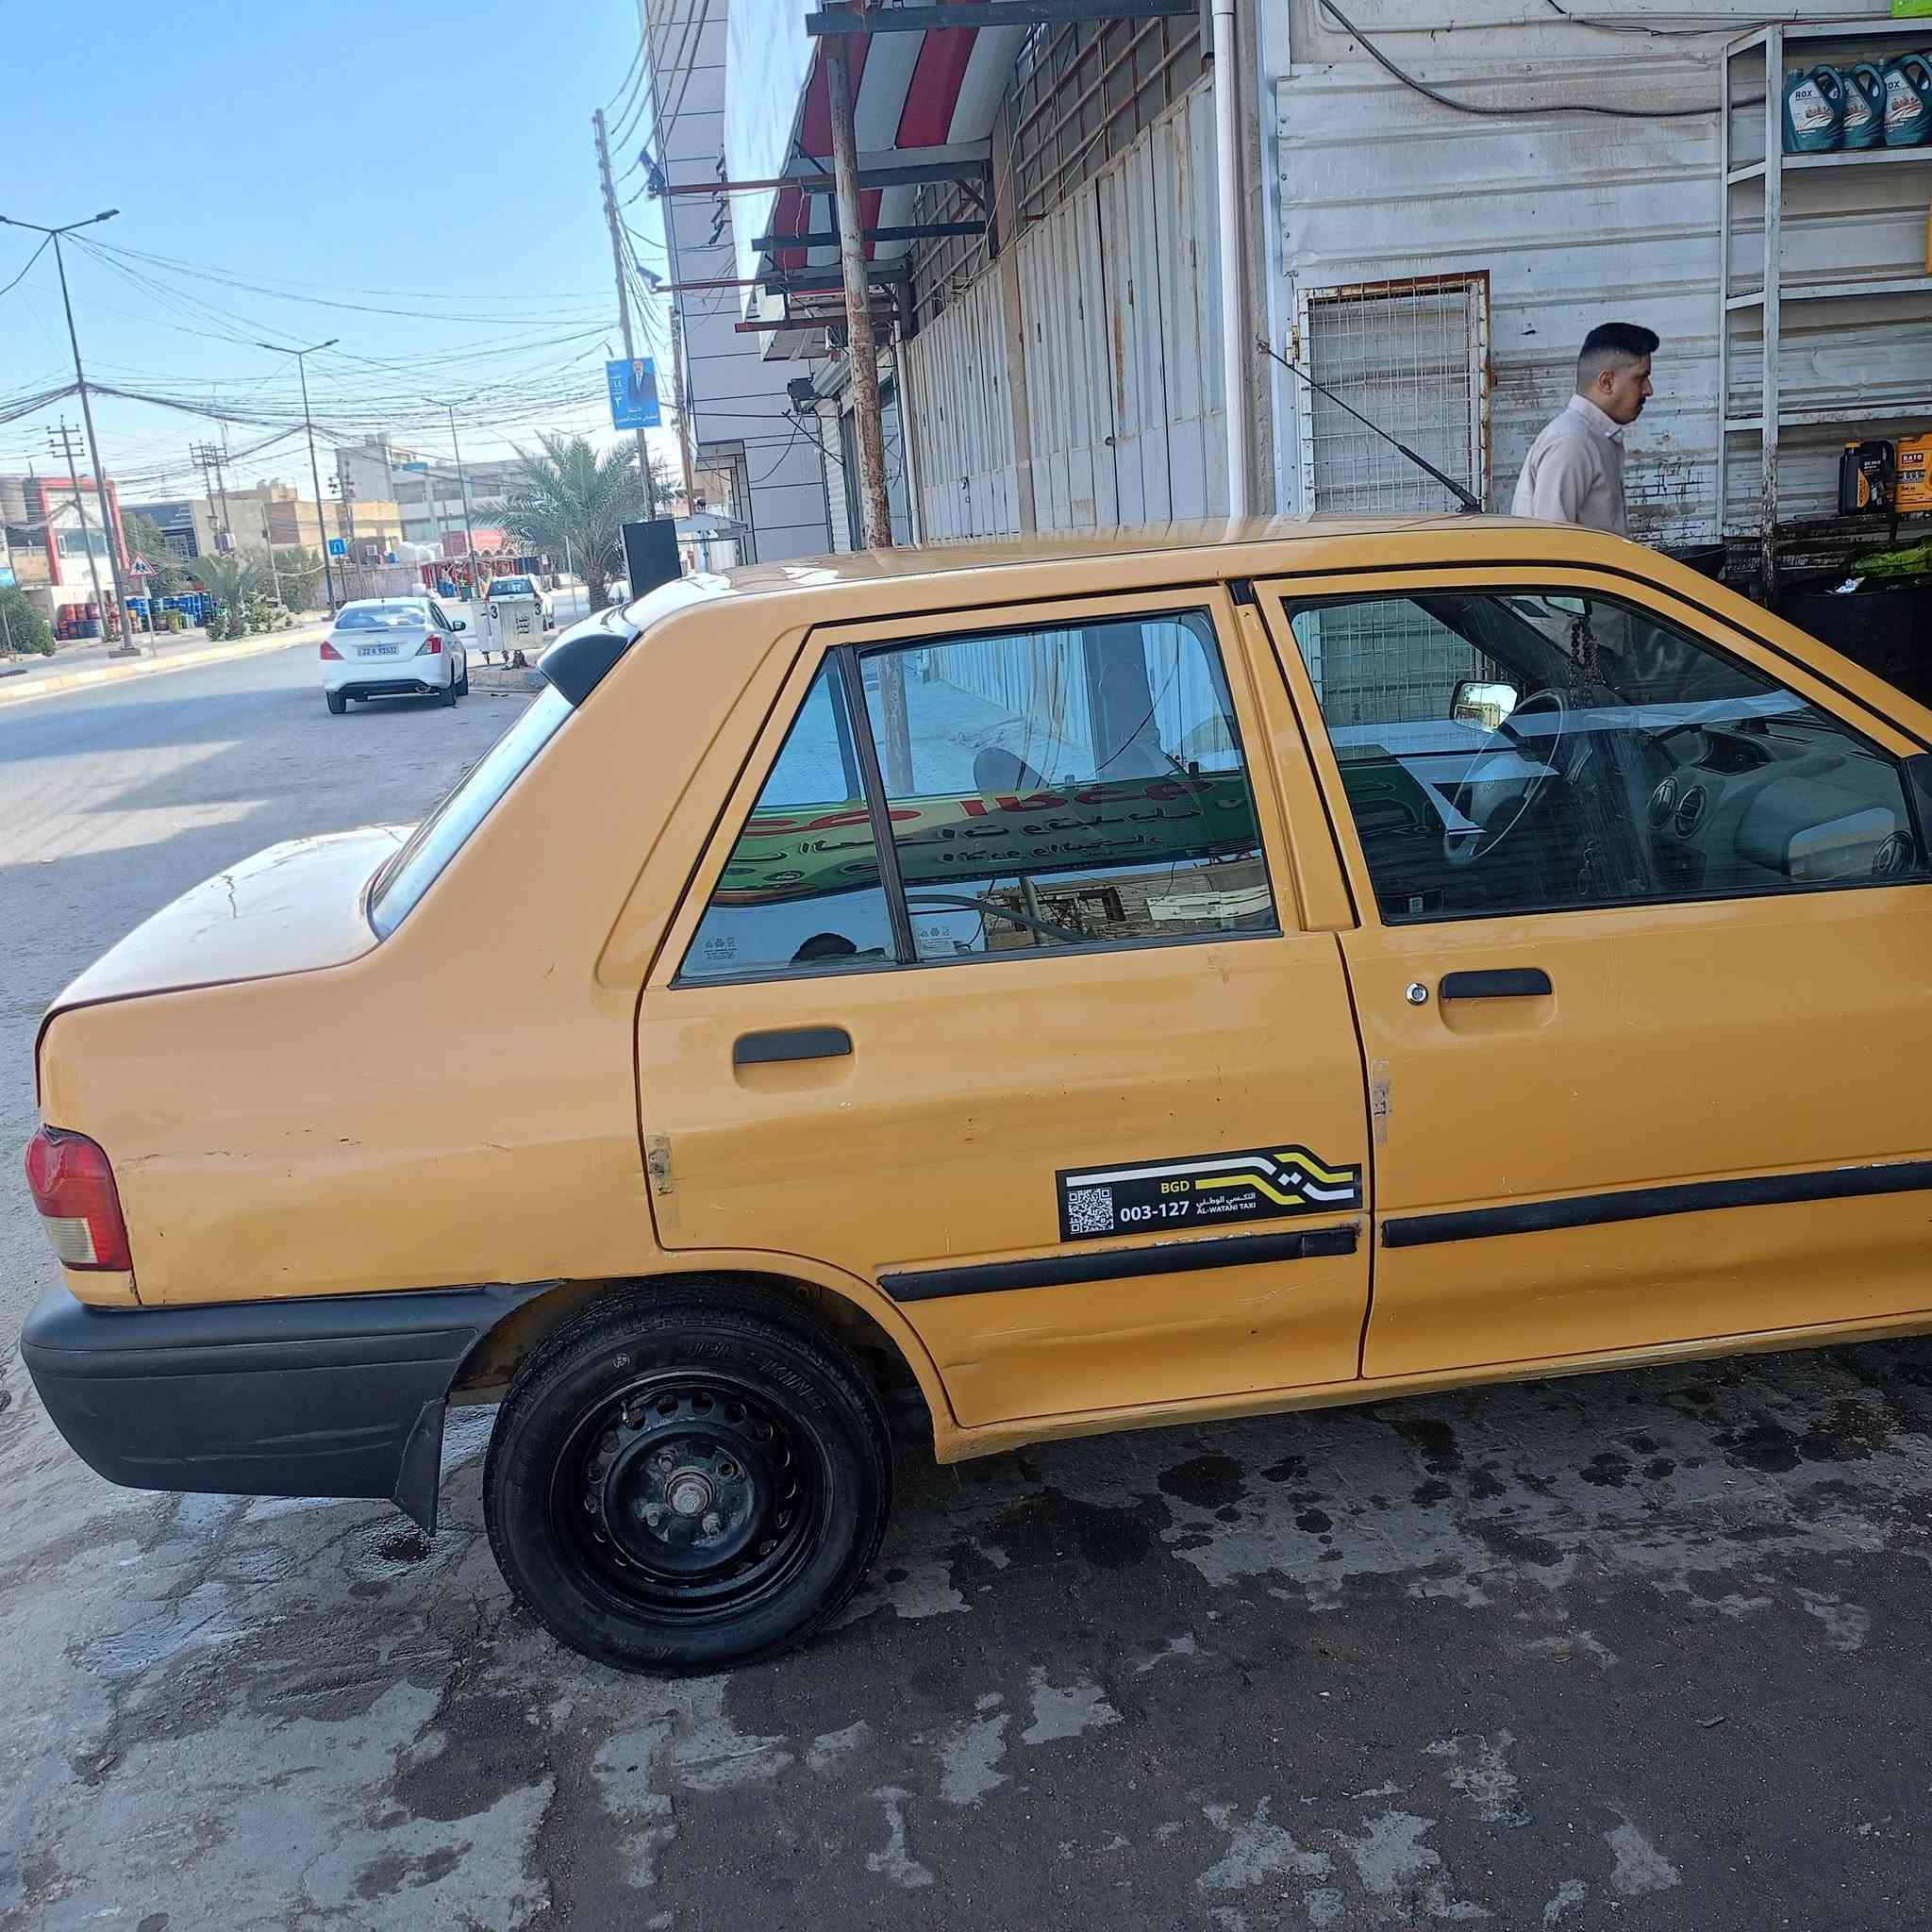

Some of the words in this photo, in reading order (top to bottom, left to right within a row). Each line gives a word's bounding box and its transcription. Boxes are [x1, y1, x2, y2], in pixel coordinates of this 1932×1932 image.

[1795, 90, 1812, 98] ROX
[491, 605, 498, 619] 3
[533, 603, 541, 615] 3
[1160, 1180, 1190, 1193] BGD
[1120, 1200, 1190, 1222] 003-127
[1196, 1205, 1239, 1215] AL-WATANI
